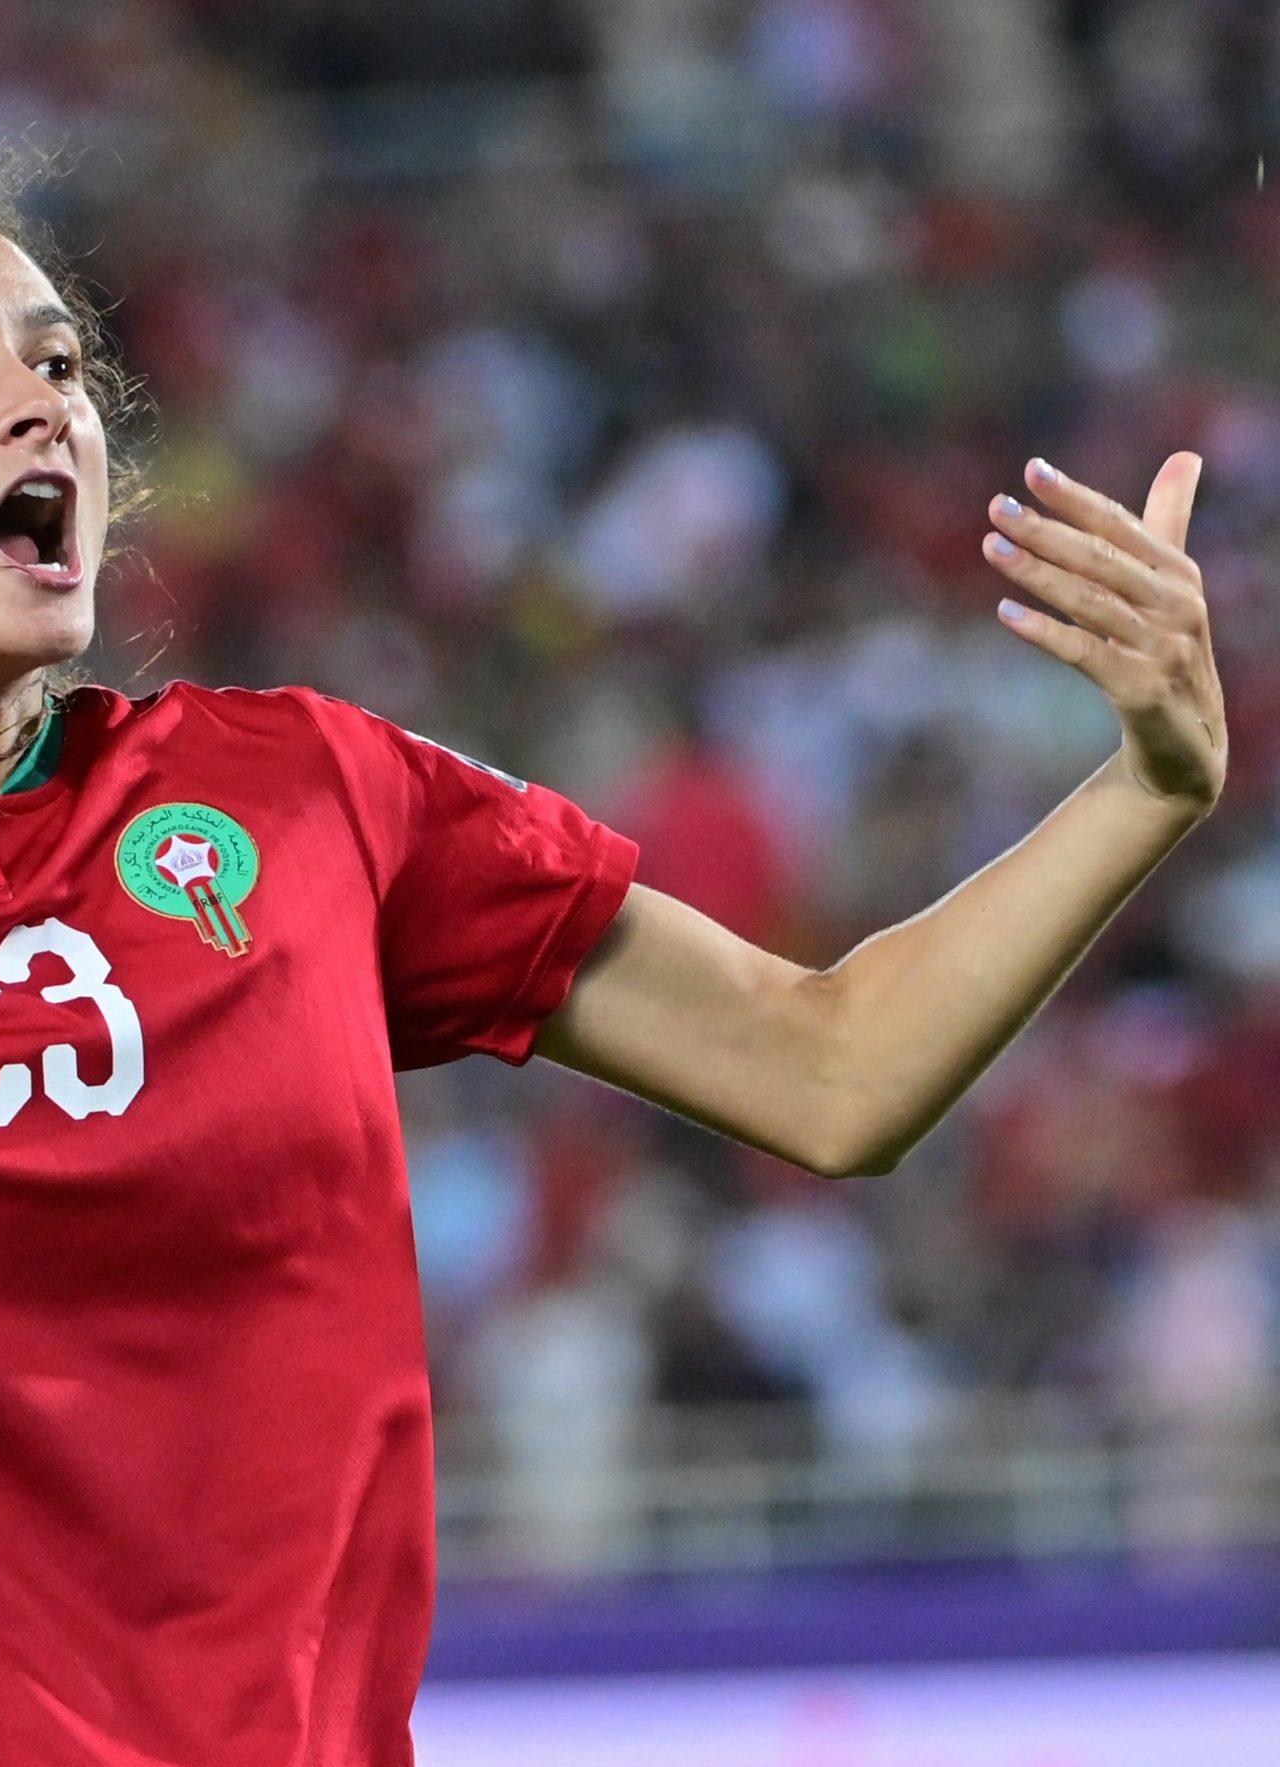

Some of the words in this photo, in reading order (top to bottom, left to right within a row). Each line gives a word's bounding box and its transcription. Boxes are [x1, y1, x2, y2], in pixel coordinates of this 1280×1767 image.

[181, 807, 226, 829] الملكية
[161, 824, 209, 835] MAROCAINE
[209, 834, 219, 843] DE
